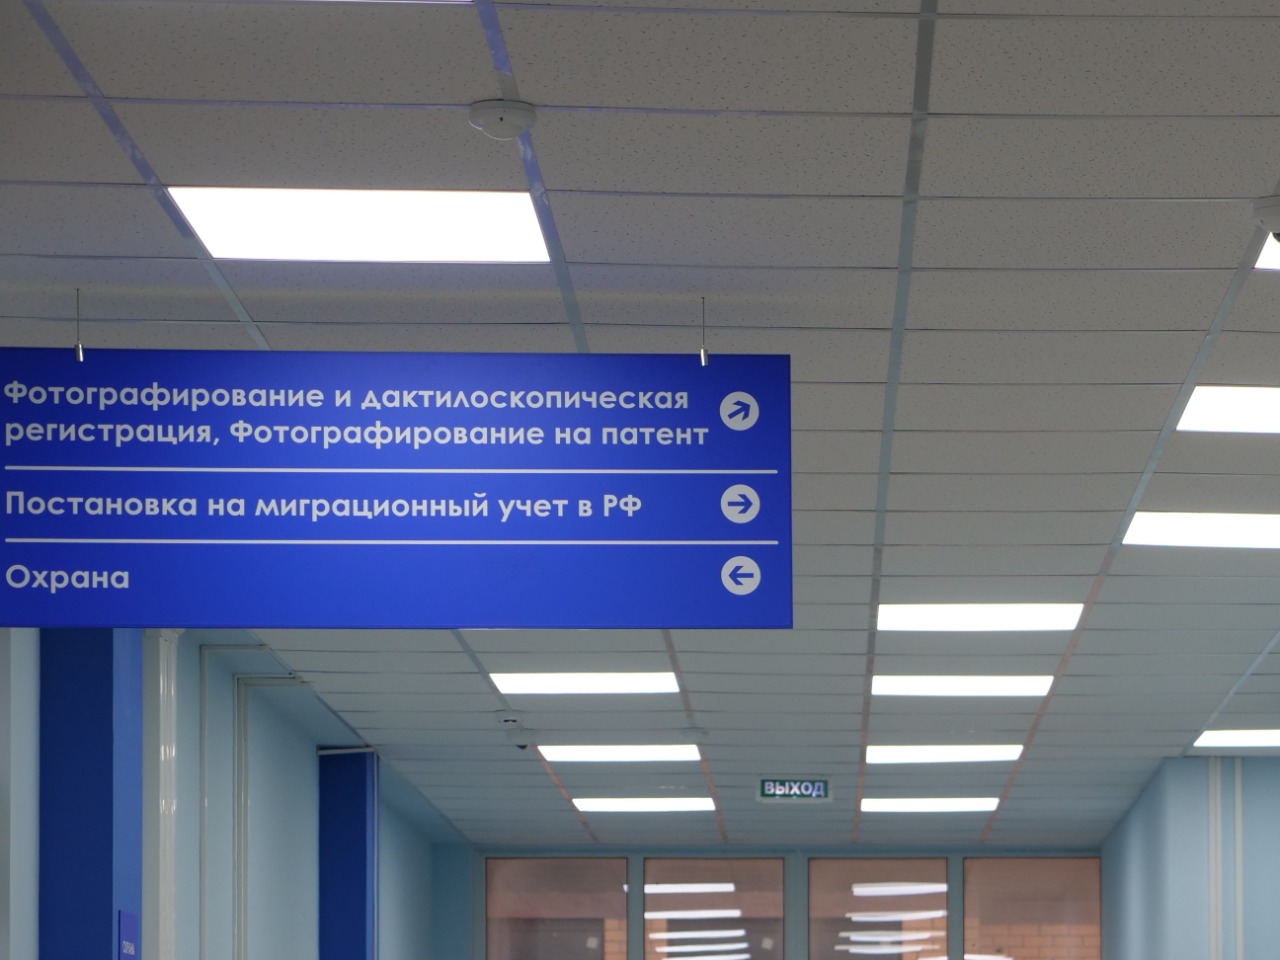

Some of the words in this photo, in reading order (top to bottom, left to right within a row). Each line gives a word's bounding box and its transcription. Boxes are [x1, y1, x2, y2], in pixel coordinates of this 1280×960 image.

[4, 381, 325, 412] Фотографирование
[334, 389, 352, 408] и
[361, 385, 689, 411] дактилоскопическая
[4, 422, 220, 448] регистрация,
[229, 420, 545, 450] Фотографирование
[554, 426, 591, 446] на
[602, 426, 709, 446] патент
[4, 490, 197, 517] Постановка
[208, 498, 246, 517] на
[254, 491, 489, 522] миграционный
[497, 498, 569, 523] учет
[577, 499, 593, 517] в
[602, 494, 643, 518] РФ
[4, 563, 130, 595] Охрана
[764, 781, 825, 797] ВЫХОД
